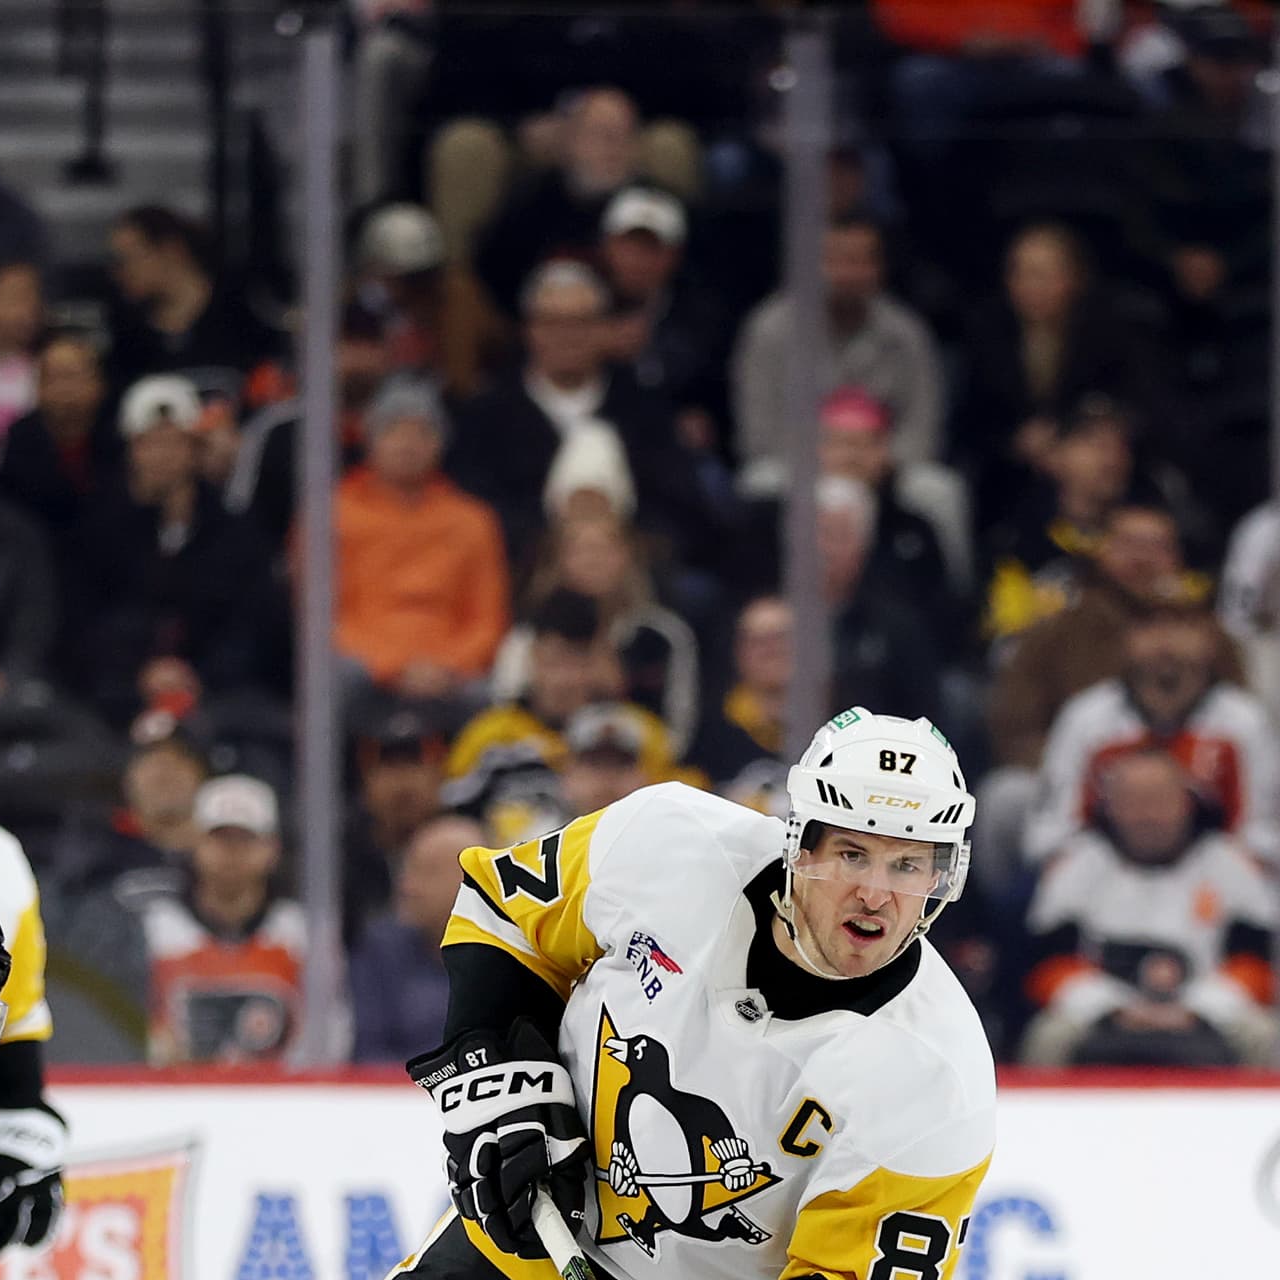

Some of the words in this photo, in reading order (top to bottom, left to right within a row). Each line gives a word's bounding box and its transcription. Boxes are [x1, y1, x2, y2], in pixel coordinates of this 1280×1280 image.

[879, 749, 917, 775] 87
[867, 794, 922, 811] CCM
[465, 1047, 489, 1068] 87
[441, 1071, 554, 1114] CCM
[777, 1096, 835, 1158] C
